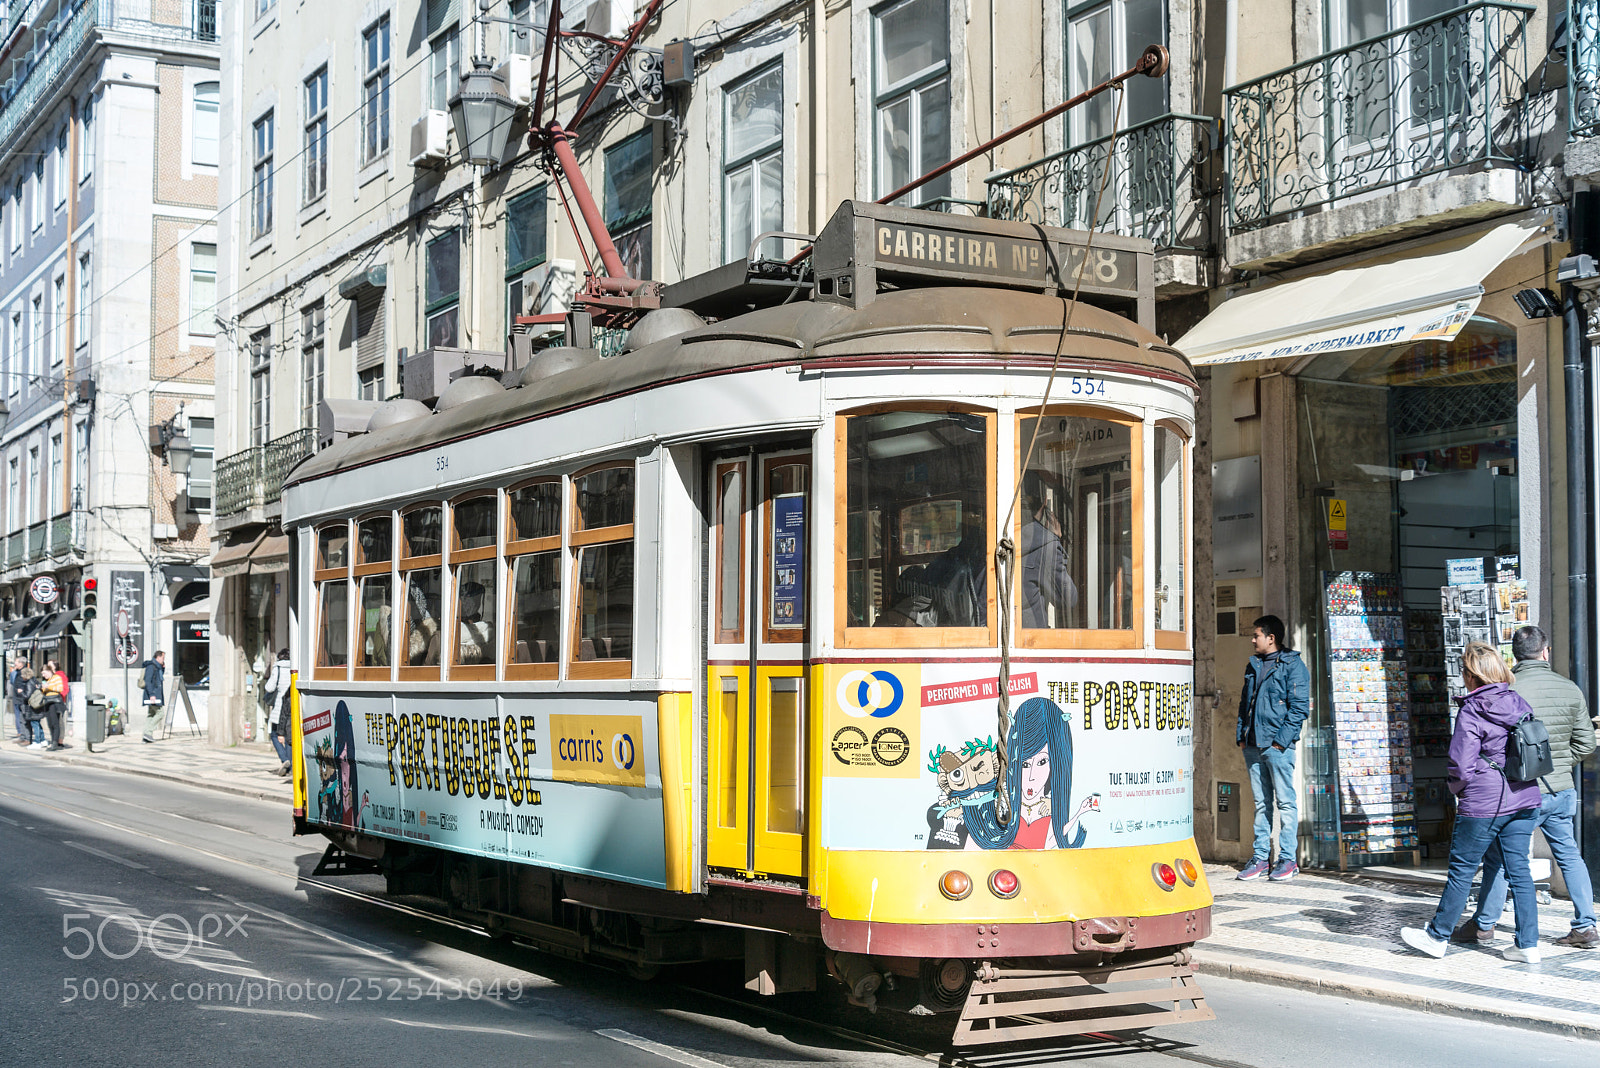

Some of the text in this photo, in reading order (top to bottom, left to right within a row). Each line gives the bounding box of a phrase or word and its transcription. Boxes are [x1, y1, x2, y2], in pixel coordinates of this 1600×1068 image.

[878, 227, 1118, 284] CARREIRA Nº 28
[1304, 326, 1405, 353] SUPERMARKET
[1071, 376, 1106, 396] 554
[1077, 426, 1114, 443] SAÍDA
[436, 456, 450, 472] 554
[1499, 555, 1519, 565] Portugal
[926, 677, 1032, 703] PERFORMED IN GLISH
[1047, 681, 1079, 703] THE
[365, 712, 384, 746] THE
[559, 729, 604, 763] carris
[838, 742, 862, 751] apcer
[385, 712, 542, 807] PORTUGUESE
[480, 809, 543, 838] A MUSICAL COMEDY
